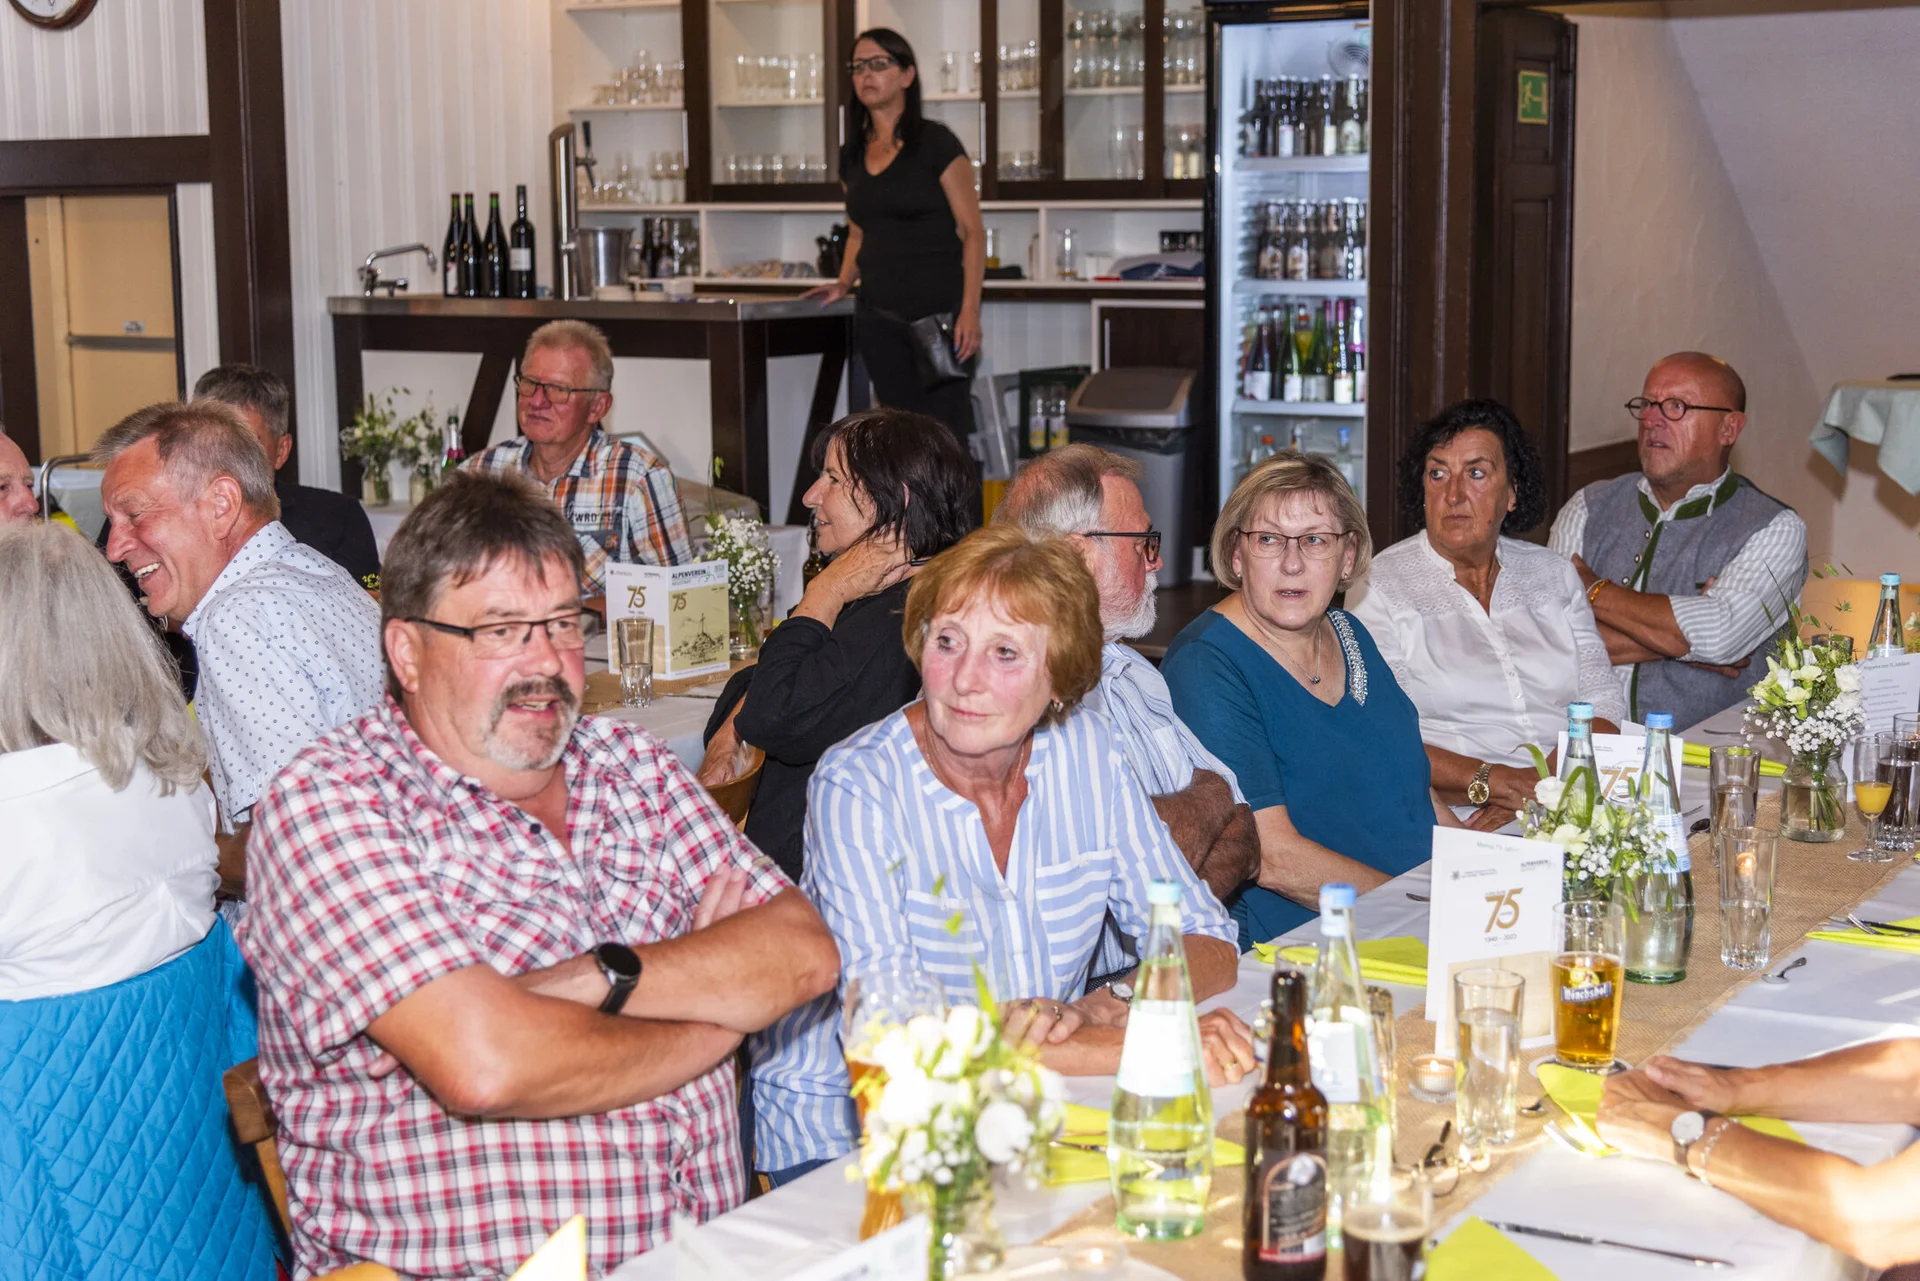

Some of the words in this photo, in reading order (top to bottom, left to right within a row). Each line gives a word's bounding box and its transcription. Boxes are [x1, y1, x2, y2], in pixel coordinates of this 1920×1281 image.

[671, 569, 707, 579] ALPENVEREIN
[627, 585, 647, 609] 75
[672, 592, 687, 612] 75
[1600, 766, 1640, 799] 75
[1484, 887, 1524, 933] 75
